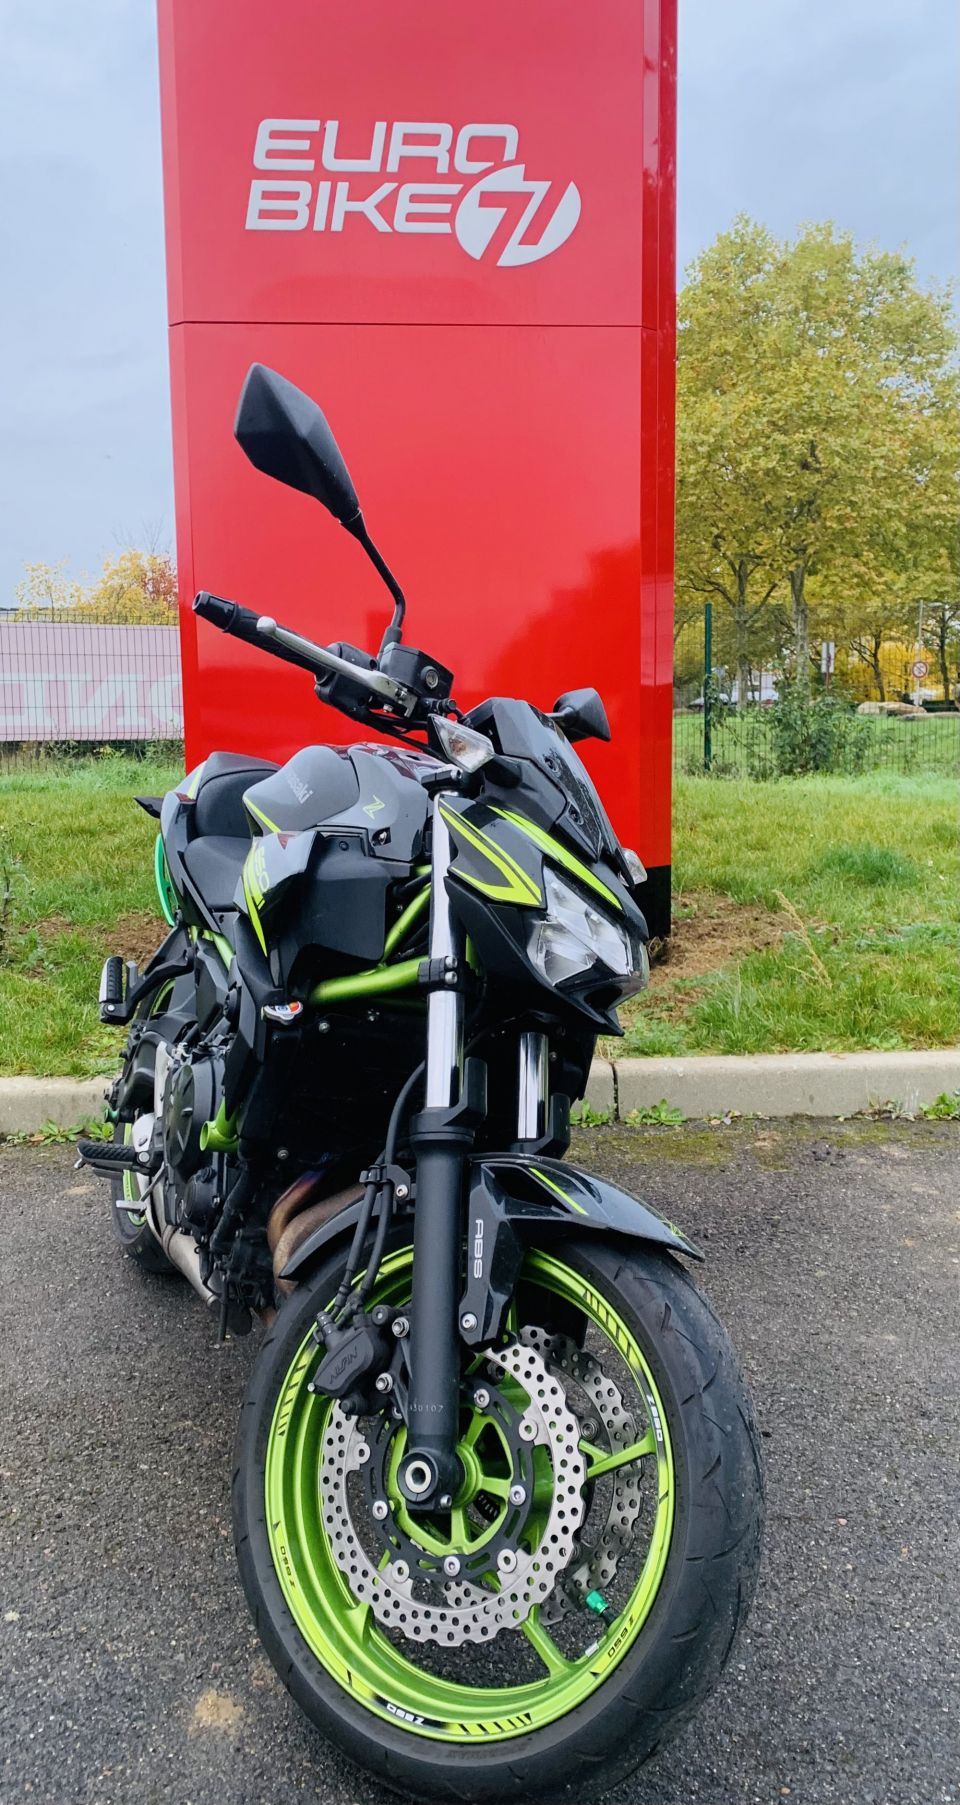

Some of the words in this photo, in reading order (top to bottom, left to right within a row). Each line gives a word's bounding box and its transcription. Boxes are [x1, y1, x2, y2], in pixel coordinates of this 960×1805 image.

[253, 118, 519, 174] EURO
[245, 179, 464, 234] BIKE
[473, 1218, 484, 1280] ABS
